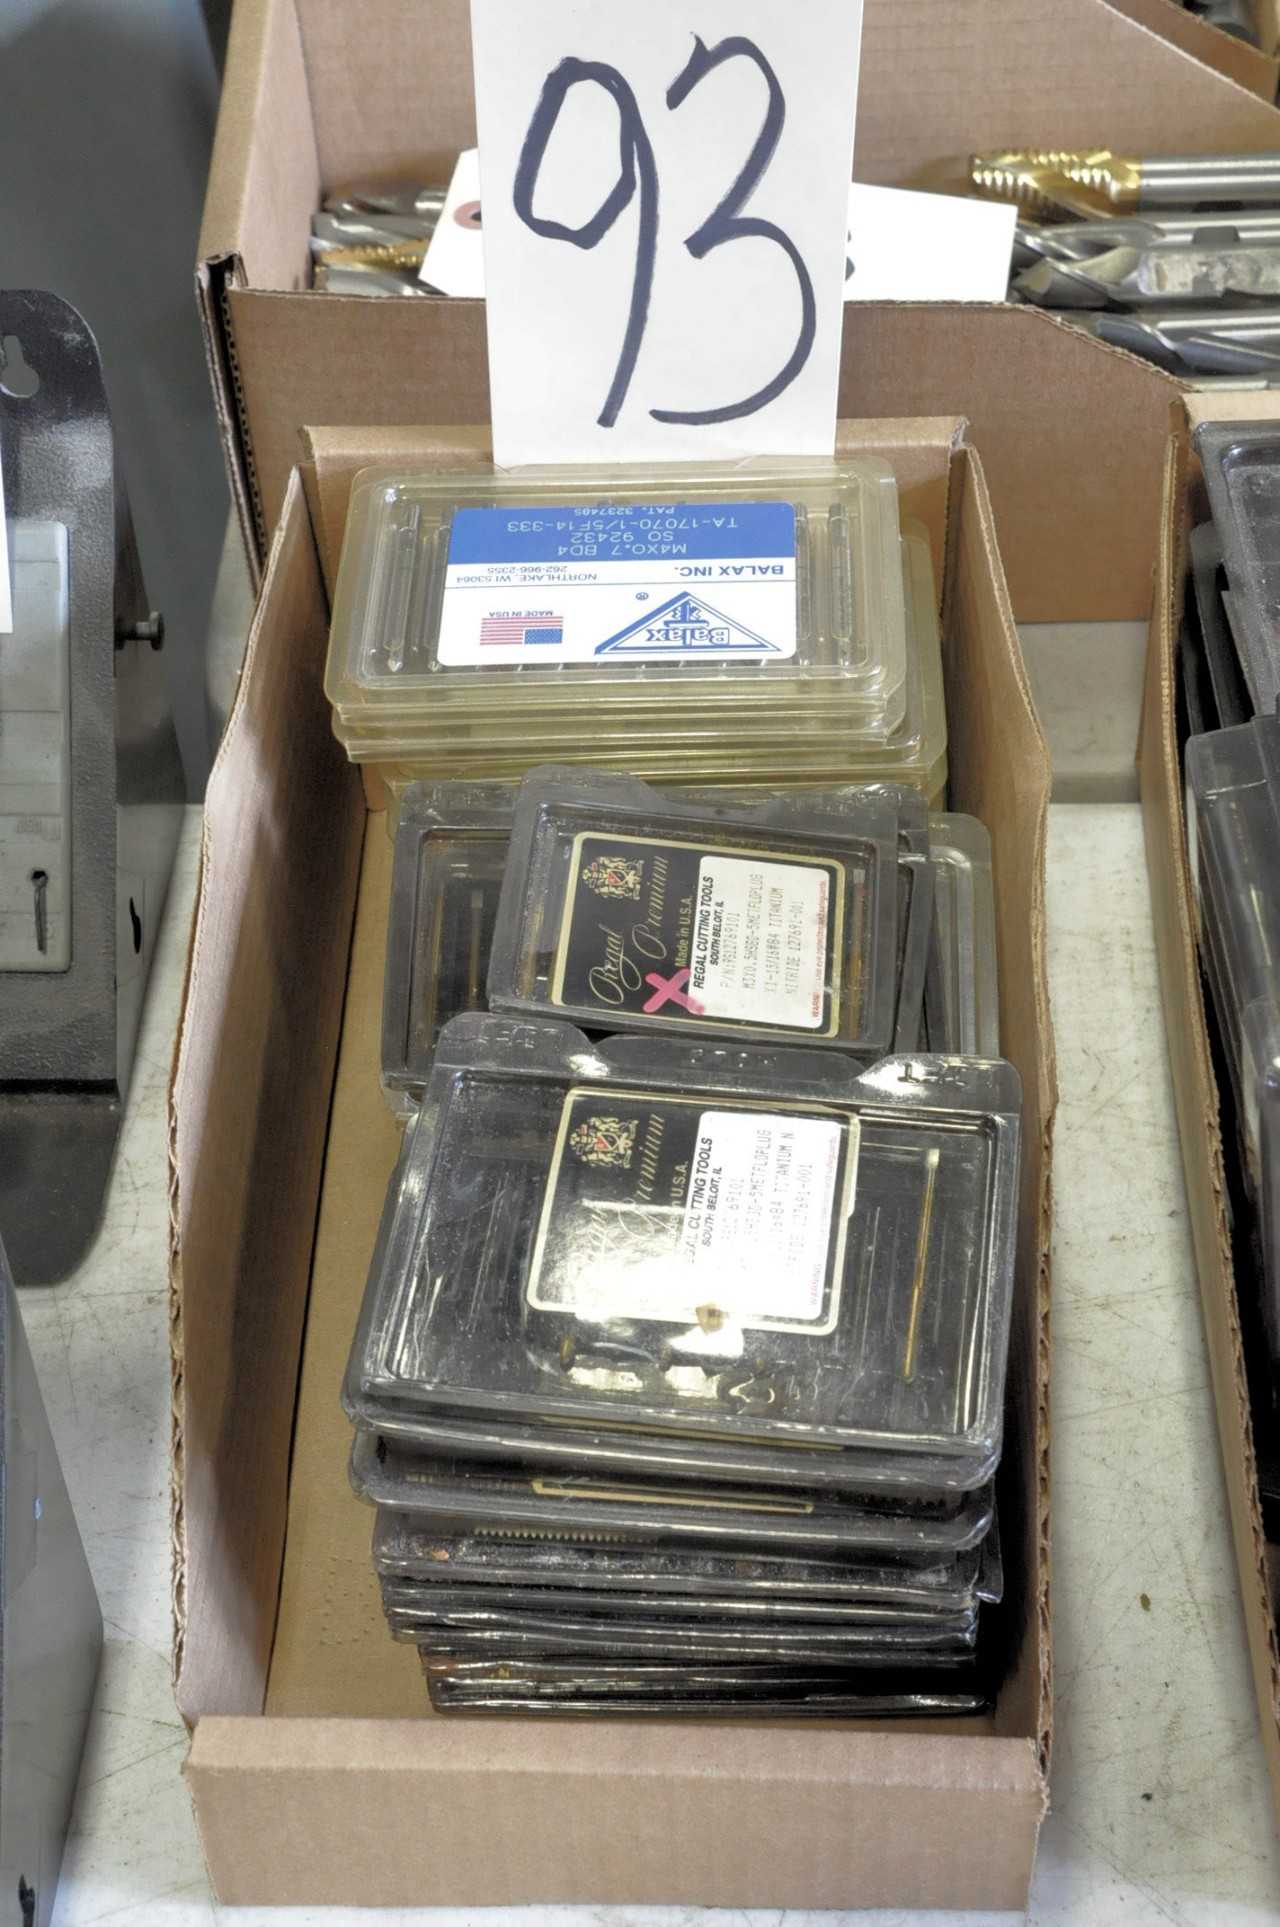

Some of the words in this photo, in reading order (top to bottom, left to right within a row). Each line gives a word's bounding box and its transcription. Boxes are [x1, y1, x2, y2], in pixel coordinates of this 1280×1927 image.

[512, 31, 817, 430] 93
[641, 506, 676, 516] PAT.
[570, 531, 635, 544] 92432
[647, 531, 674, 542] SO
[557, 543, 598, 556] BD4
[496, 575, 511, 583] WI
[674, 566, 713, 577] INC.
[719, 565, 785, 577] BALAX
[488, 610, 510, 618] USA
[510, 610, 523, 618] IN
[525, 609, 554, 617] MADE
[645, 627, 731, 646] Balax
[702, 876, 714, 908] TOOLS
[631, 855, 669, 960] Premium
[679, 895, 694, 925] U.S.A.
[680, 927, 691, 939] in
[697, 910, 711, 953] CUTTING
[674, 940, 690, 967] Made
[709, 938, 720, 966] SOUTH
[588, 923, 642, 1005] Regal
[693, 954, 705, 990] REGAL
[695, 1137, 713, 1175] TOOLS
[671, 1160, 689, 1199] U.S.A.
[706, 1176, 721, 1211] BELOIT,
